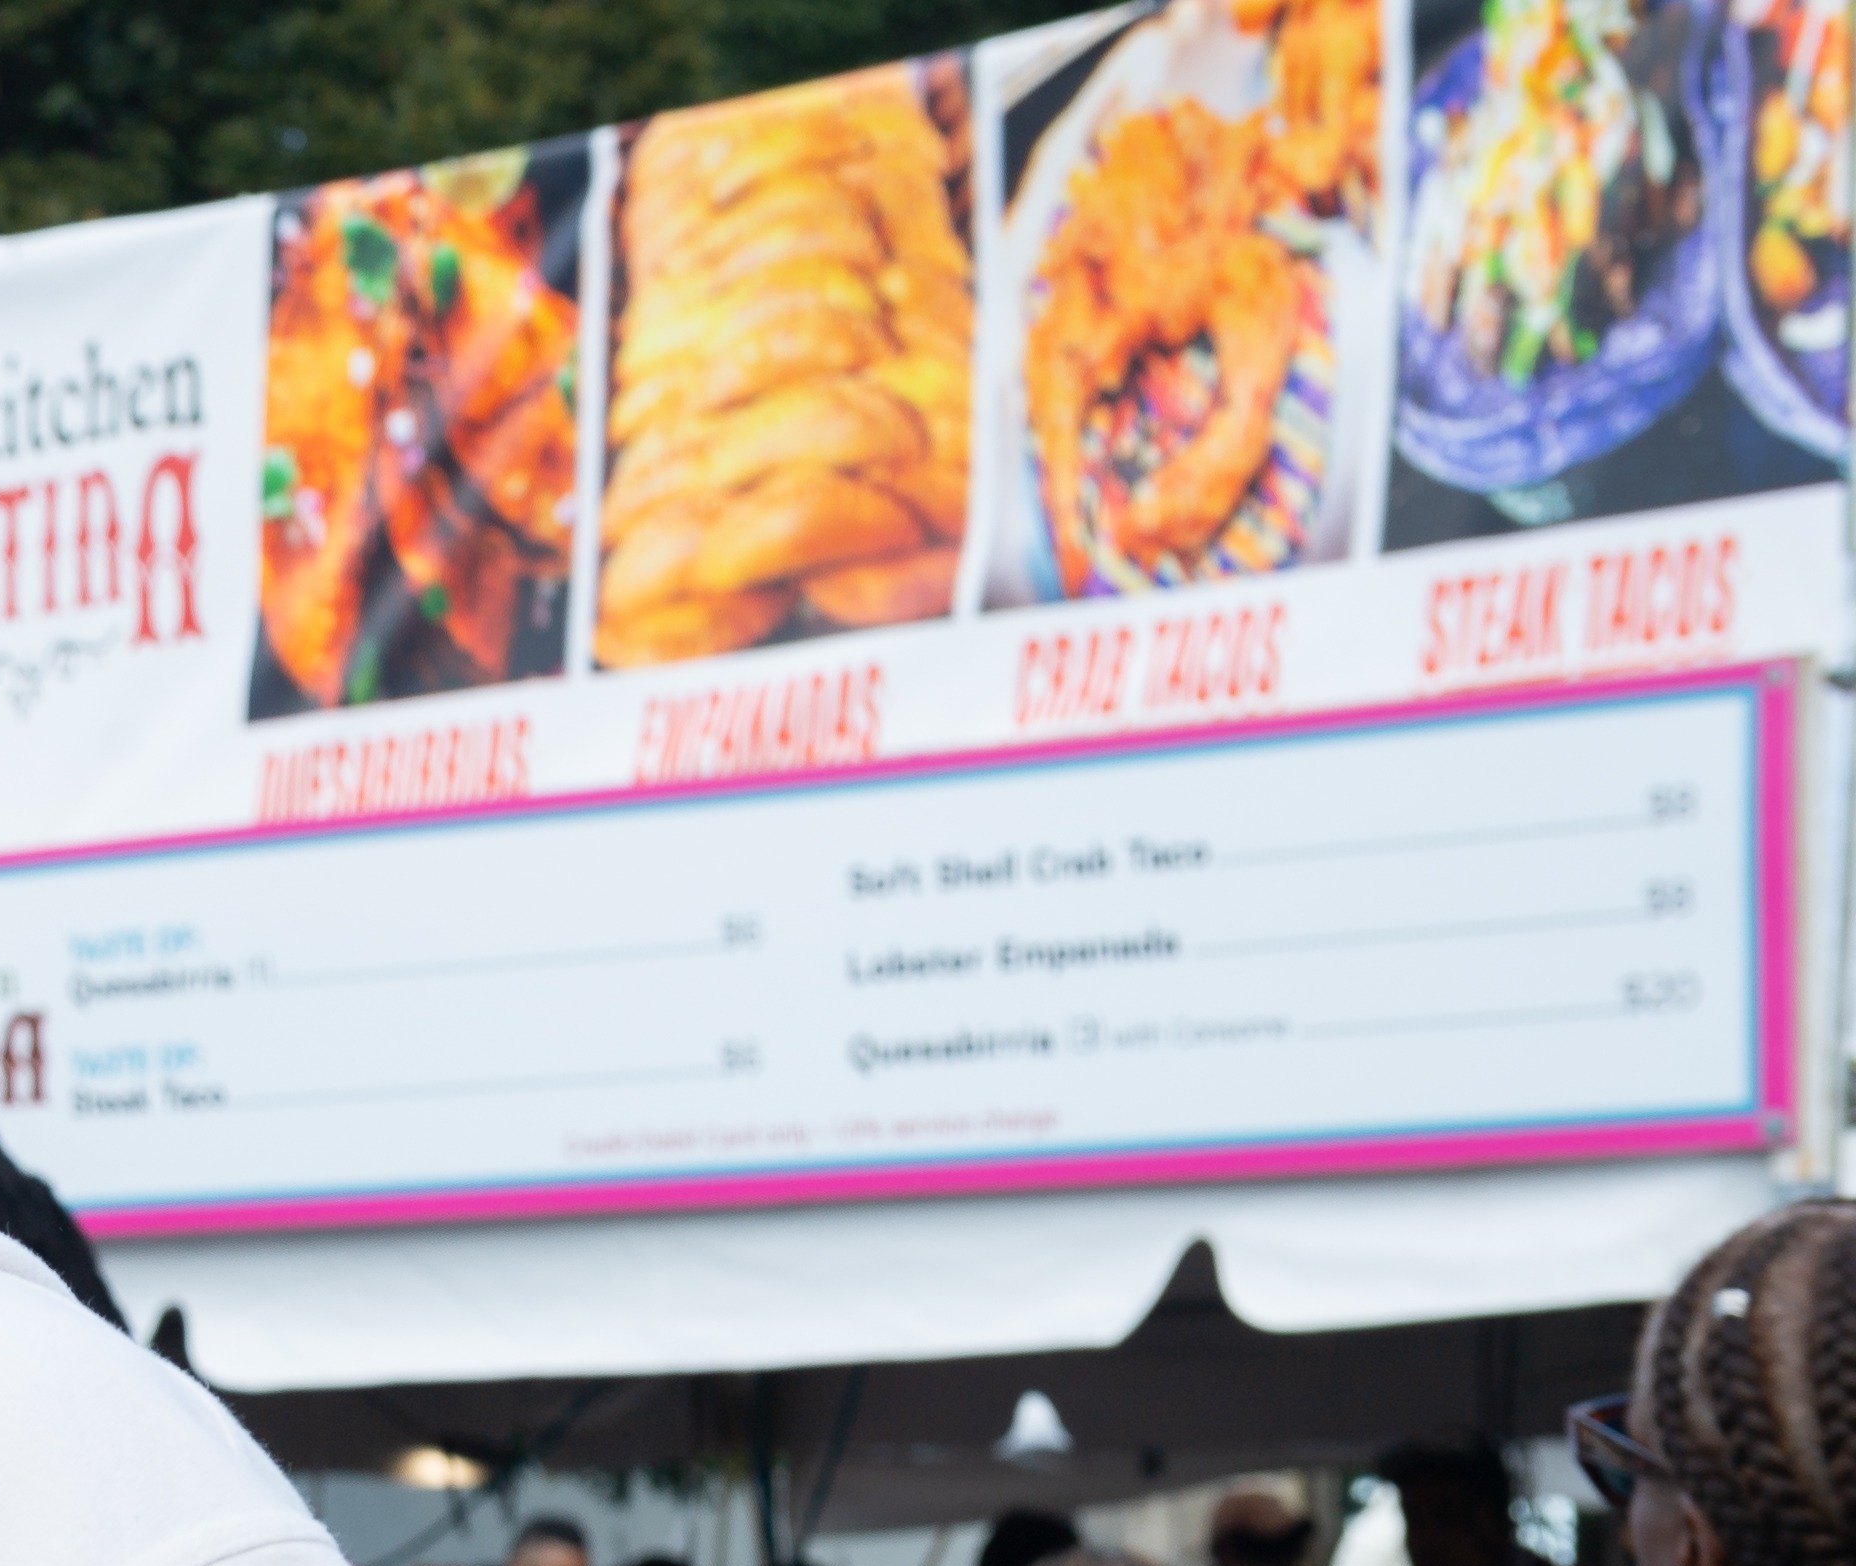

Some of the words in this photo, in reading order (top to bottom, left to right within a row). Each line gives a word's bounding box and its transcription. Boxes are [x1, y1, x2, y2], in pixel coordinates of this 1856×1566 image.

[1422, 558, 1568, 676] STEAK
[1585, 536, 1738, 654] TACOS
[1012, 625, 1130, 728] CRAB
[1141, 603, 1286, 708] TACOS
[1030, 844, 1112, 884] Crab
[1130, 835, 1210, 873] Taco
[845, 946, 983, 986] Lobster
[996, 925, 1181, 979] Empanada
